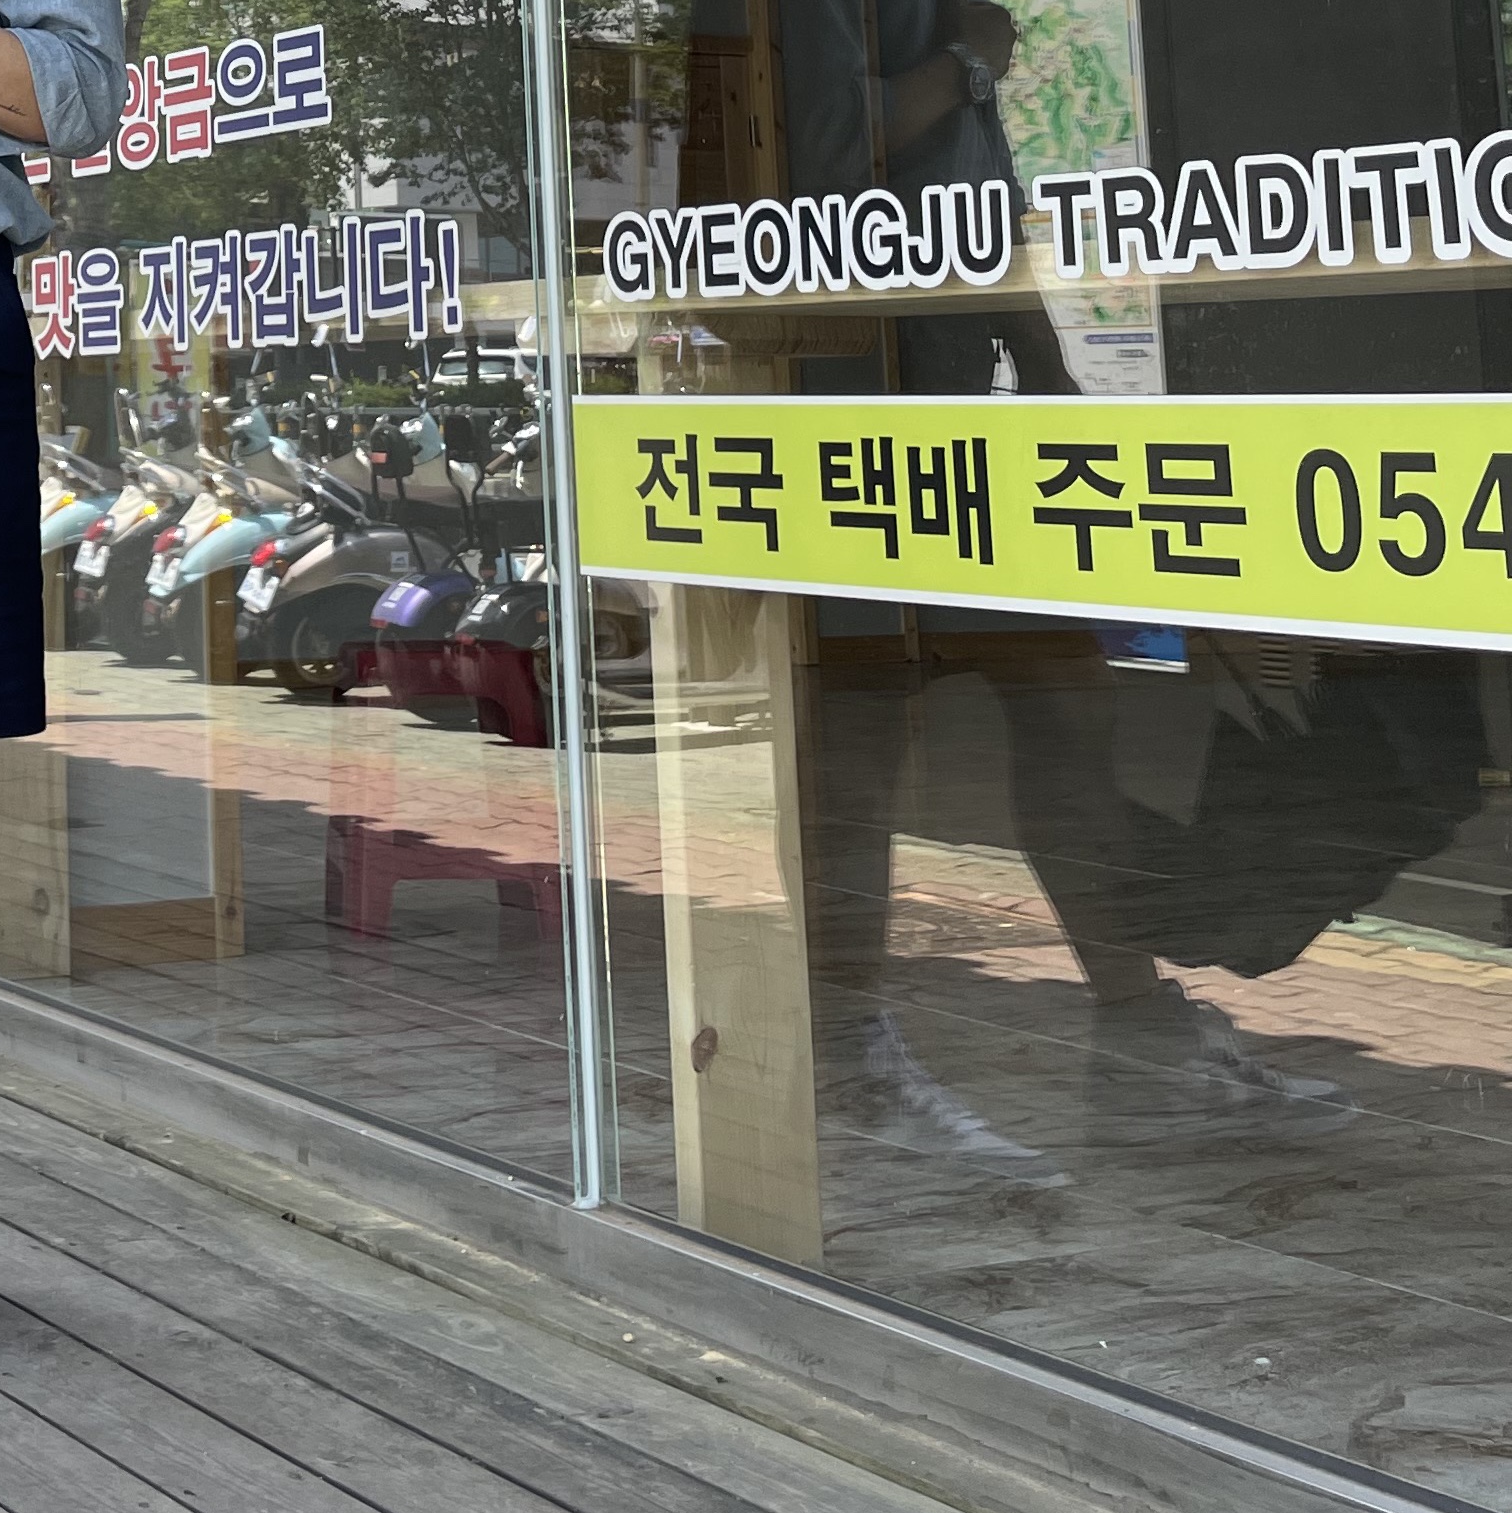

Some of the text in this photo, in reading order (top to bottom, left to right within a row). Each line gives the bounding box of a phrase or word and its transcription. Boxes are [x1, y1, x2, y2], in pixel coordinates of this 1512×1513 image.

[71, 24, 332, 178] 앙금으로
[31, 209, 463, 361] 맛을 지켜갑니다!
[604, 179, 1013, 302] GYEONGJU
[636, 433, 1512, 580] 전국 택배 주문 054
